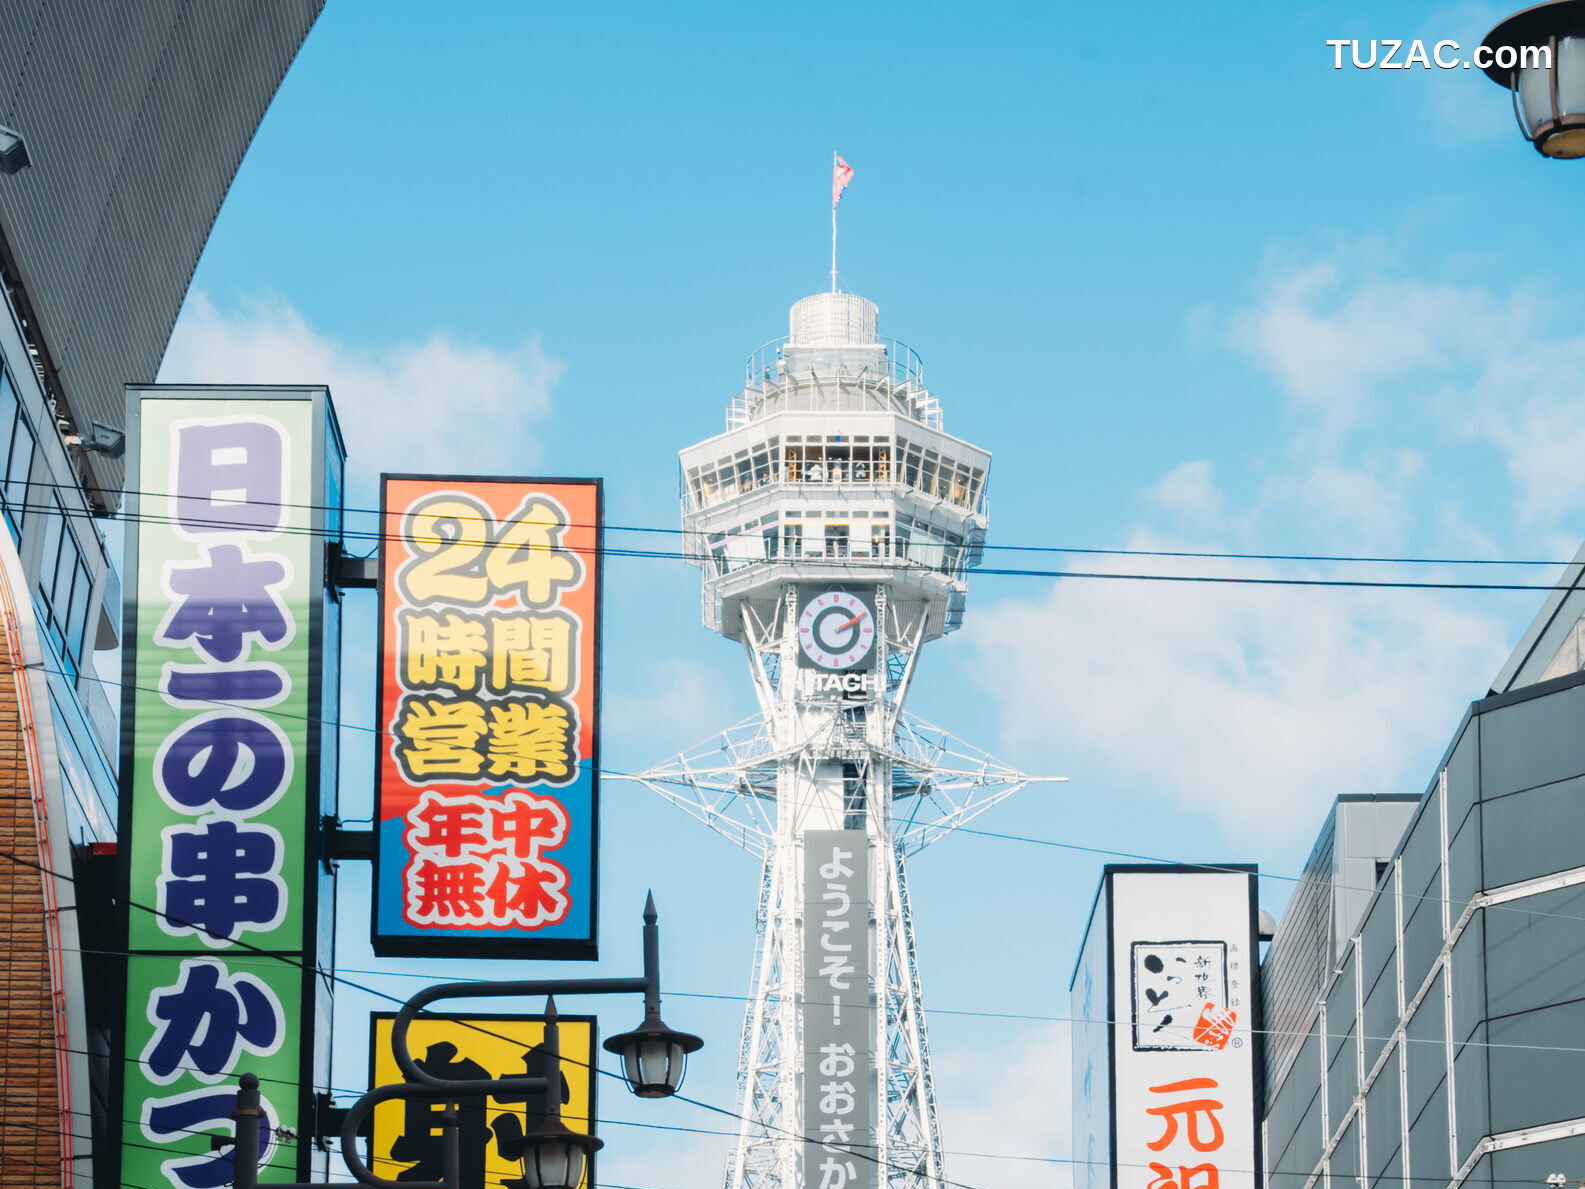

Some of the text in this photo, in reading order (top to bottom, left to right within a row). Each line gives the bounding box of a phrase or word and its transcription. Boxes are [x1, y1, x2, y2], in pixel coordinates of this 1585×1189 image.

[396, 491, 586, 608] 24
[400, 610, 581, 697] 時間
[394, 698, 580, 787] 営業
[404, 790, 570, 858] 年中
[403, 857, 571, 928] 無休
